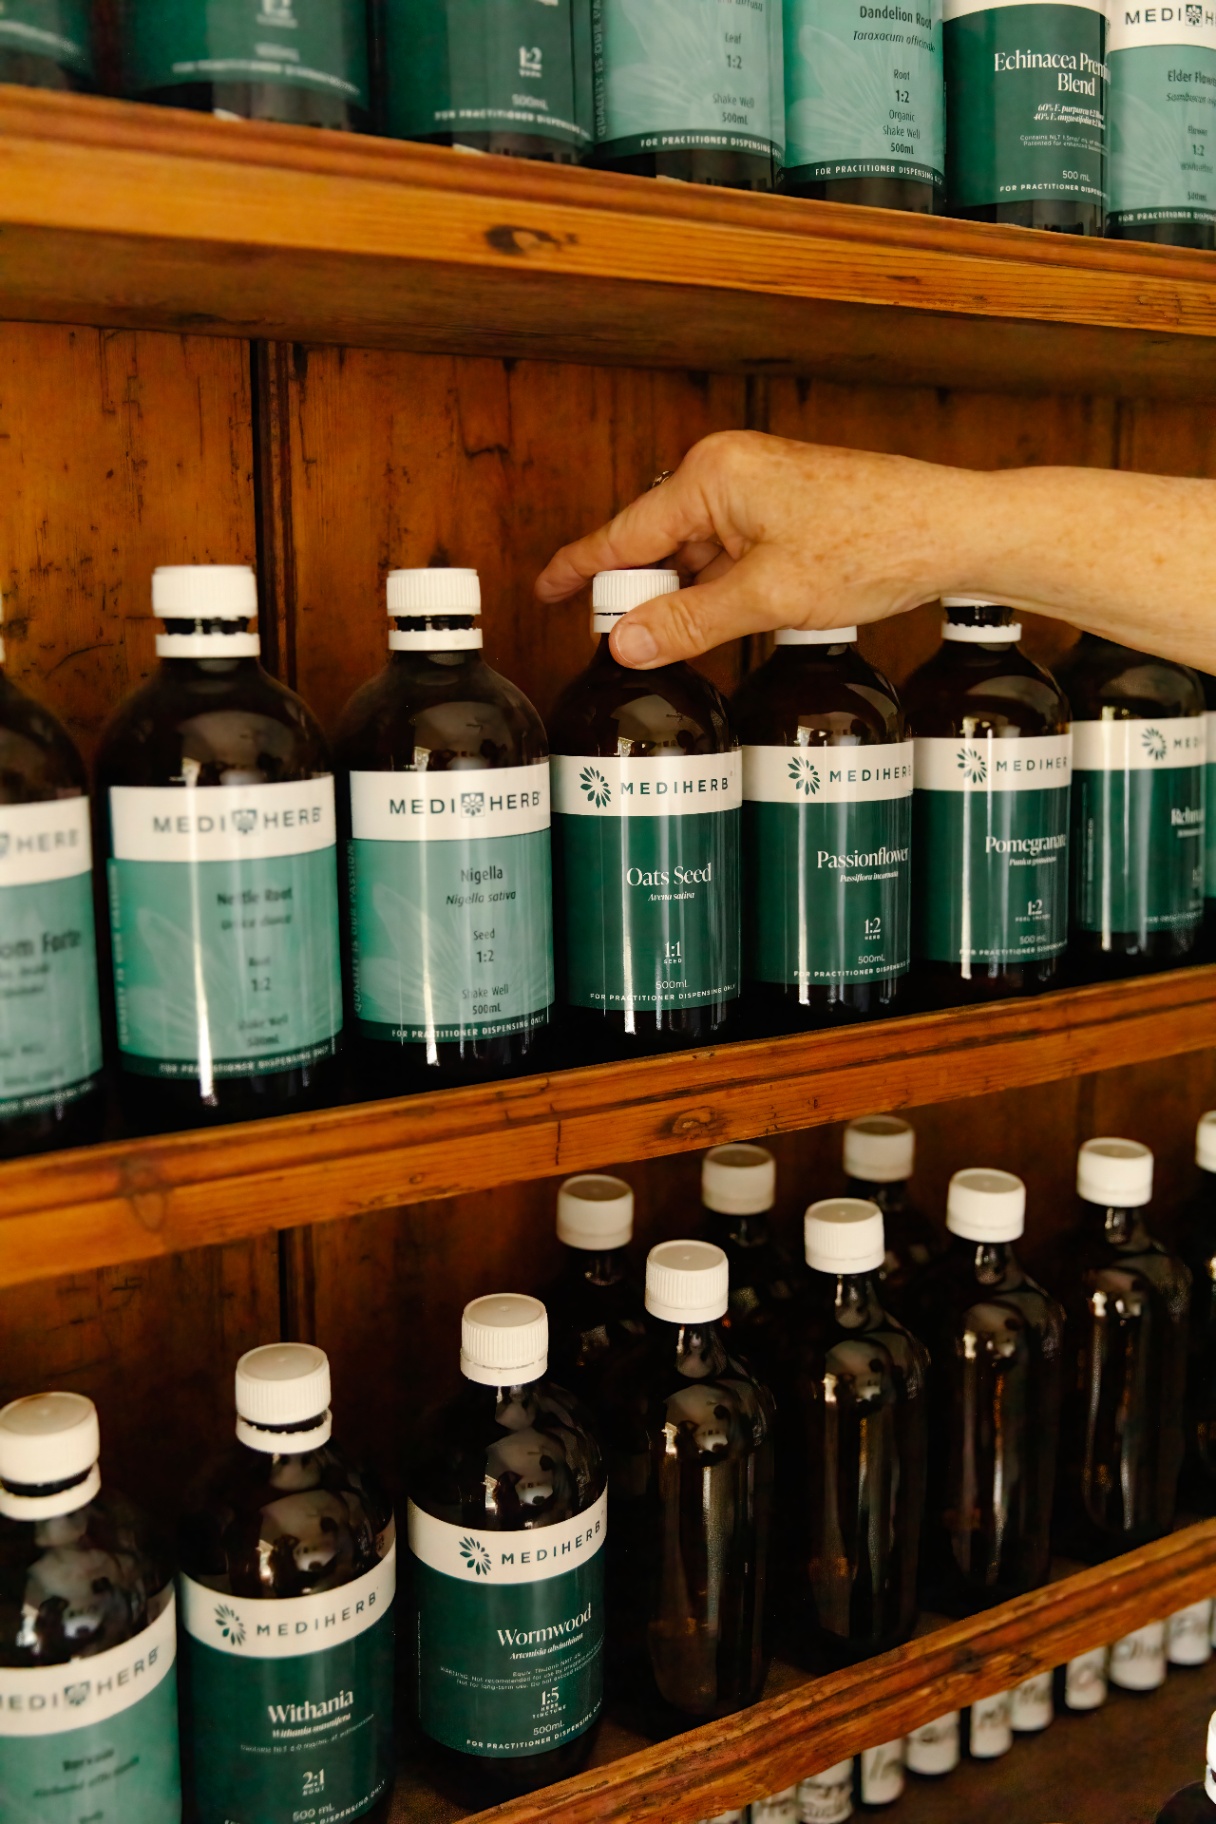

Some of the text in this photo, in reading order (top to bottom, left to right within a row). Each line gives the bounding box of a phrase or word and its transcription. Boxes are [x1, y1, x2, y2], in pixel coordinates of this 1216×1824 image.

[860, 5, 932, 30] Dandelion Root
[1125, 8, 1181, 25] MEDI
[725, 32, 742, 45] Leaf
[853, 30, 936, 53] Taraxacum officinale
[519, 46, 542, 70] 1:2
[726, 54, 743, 70] 1:2
[994, 49, 1077, 72] Echinacea
[894, 69, 910, 81] Root
[1167, 69, 1192, 82] Elder
[1058, 73, 1095, 96] Blend
[712, 93, 755, 109] Shake Well
[895, 89, 910, 104] 1:2
[722, 112, 749, 126] 500mL
[889, 109, 915, 123] Organic
[883, 125, 920, 140] Shake Well
[640, 137, 658, 148] FOR
[662, 135, 727, 146] PRACTITIONER
[730, 137, 771, 153] DISPENSING
[890, 142, 914, 155] 500mL
[1192, 144, 1205, 157] 1:2
[815, 167, 831, 176] FOR
[836, 164, 895, 174] PRACTITIONER
[899, 166, 933, 181] DISPENSING
[1062, 170, 1090, 182] 500 mL
[1000, 185, 1017, 193] FOR
[1021, 183, 1080, 192] PRACTITIONER
[621, 777, 729, 795] MEDIHERB
[389, 791, 540, 814] MEDI HERB
[154, 807, 321, 833] MEDI HERB
[817, 847, 908, 869] Passionflower
[460, 865, 503, 884] Nigella
[626, 862, 711, 886] Oats Seed
[446, 890, 516, 907] Nigella sativa
[648, 891, 695, 901] Avena sativa
[1028, 899, 1043, 915] 1:2
[864, 917, 881, 934] 1:2
[473, 929, 495, 941] Seed
[1020, 935, 1035, 945] 500
[476, 950, 494, 963] 1:2
[664, 941, 681, 958] 1:1
[858, 954, 885, 965] 500mL
[814, 968, 873, 977] PRACTITIONER
[491, 984, 509, 996] Well
[656, 980, 688, 990] 500mL
[679, 987, 722, 999] DISPENSING
[723, 984, 736, 992] ONLY
[472, 1003, 501, 1015] 500mL
[391, 1014, 544, 1038] FOR PRATITIONER DISPENSING ONLY
[501, 1520, 601, 1565] MEDIHERB
[256, 1592, 376, 1637] MEDIHERB
[496, 1602, 592, 1647] Wormwood
[509, 1632, 584, 1660] Artemisia absinthium
[0, 1646, 159, 1711] EDI HERB
[541, 1686, 560, 1706] 1:5
[268, 1690, 354, 1723] Withania
[532, 1704, 566, 1719] TINCTURE
[466, 1712, 592, 1749] FOR PRACTITIONER DISPENSING
[533, 1720, 564, 1736] 500mL
[302, 1768, 325, 1789] 2:1
[292, 1803, 335, 1822] 500 mL
